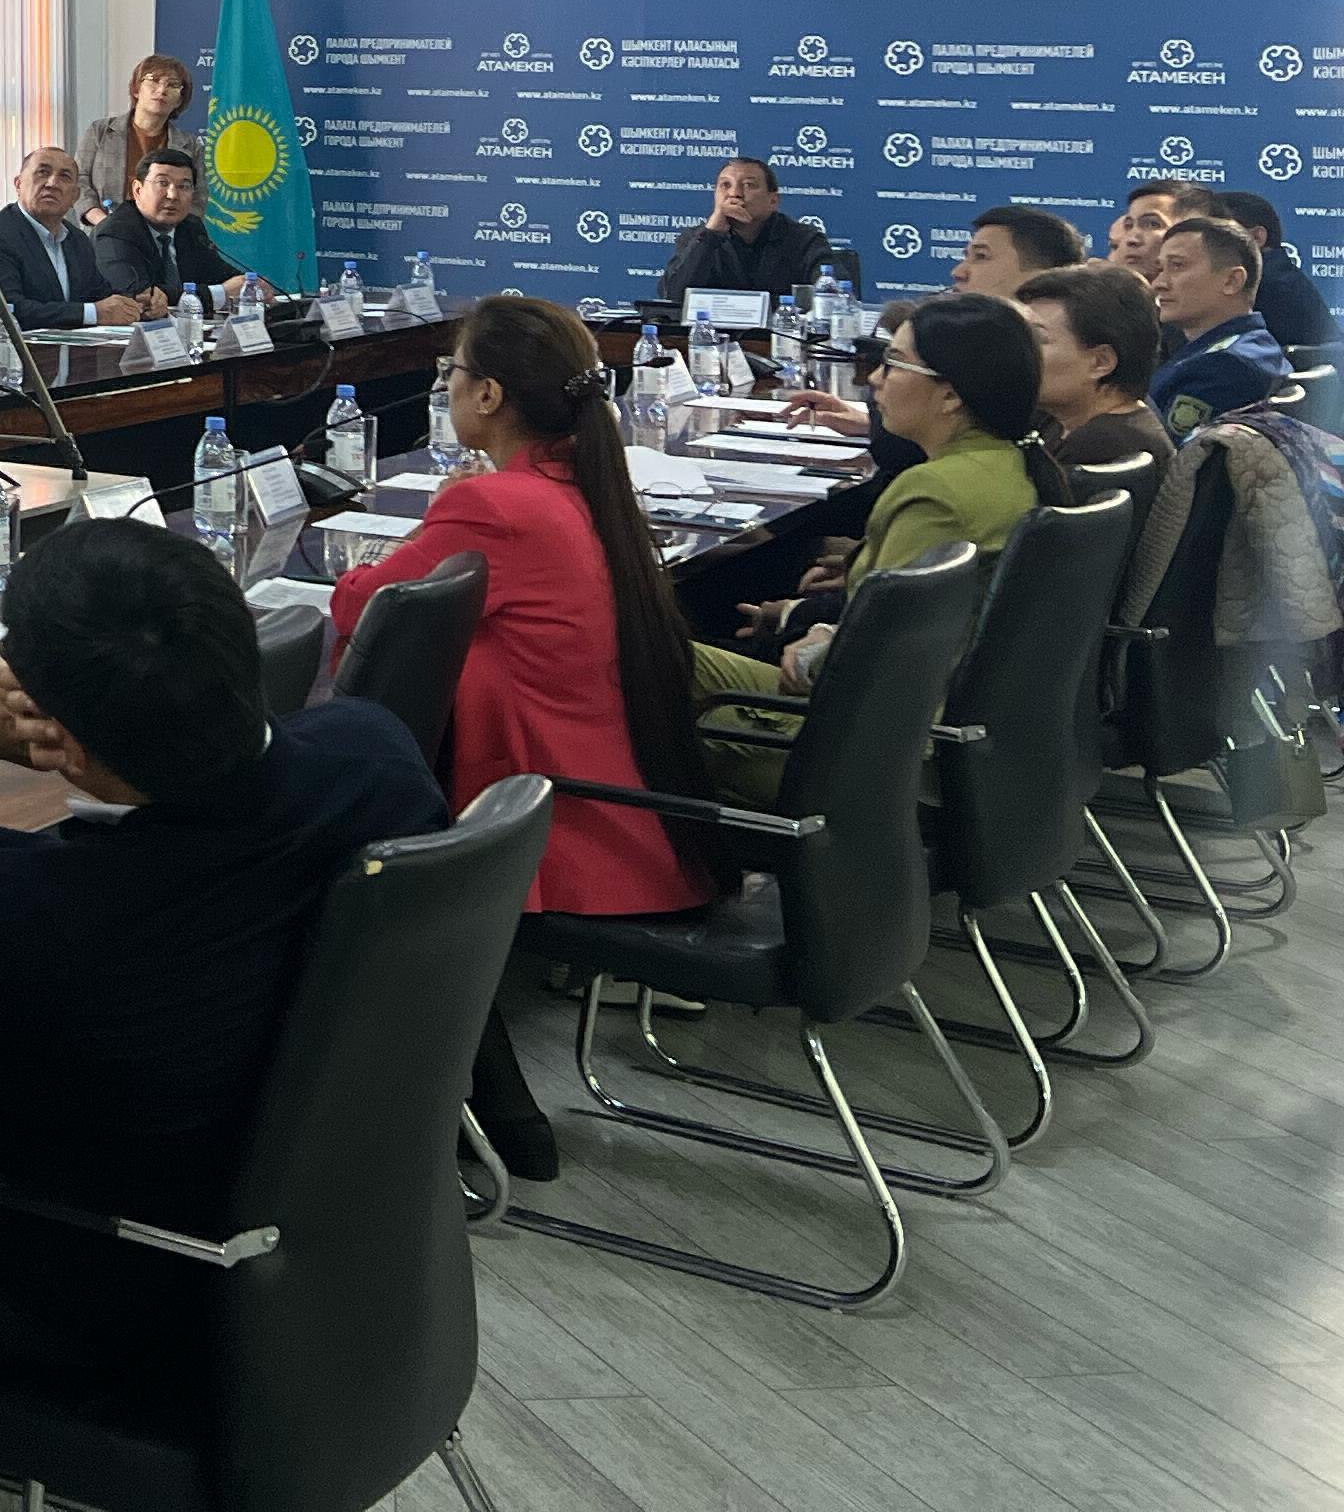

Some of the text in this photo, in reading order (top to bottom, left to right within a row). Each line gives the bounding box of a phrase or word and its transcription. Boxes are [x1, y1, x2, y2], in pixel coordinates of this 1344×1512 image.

[326, 37, 358, 49] ПАЛАТА
[621, 39, 672, 52] ШЫМКЕНТ
[325, 53, 407, 66] ГОРОДА ШЫМКЕНТ
[477, 60, 554, 73] АТАМЕКЕН
[687, 56, 740, 70] ПАЛАТАСЫ
[768, 64, 856, 78] АТАМЕКЕН
[1127, 70, 1226, 85] АТАМЕКЕН
[620, 127, 671, 140] ШЫМКЕНТ
[476, 145, 553, 159] АТАМЕКЕН
[686, 144, 739, 158] ПАЛАТАСЫ
[768, 155, 855, 169] АТАМЕКЕН
[515, 175, 601, 187] www.atameken.kz
[1126, 166, 1226, 183] АТАМЕКЕН
[619, 214, 670, 227] ШЫМКЕНТ
[474, 229, 551, 244] АТАМЕКЕН
[513, 260, 600, 274] www.atameken.kz
